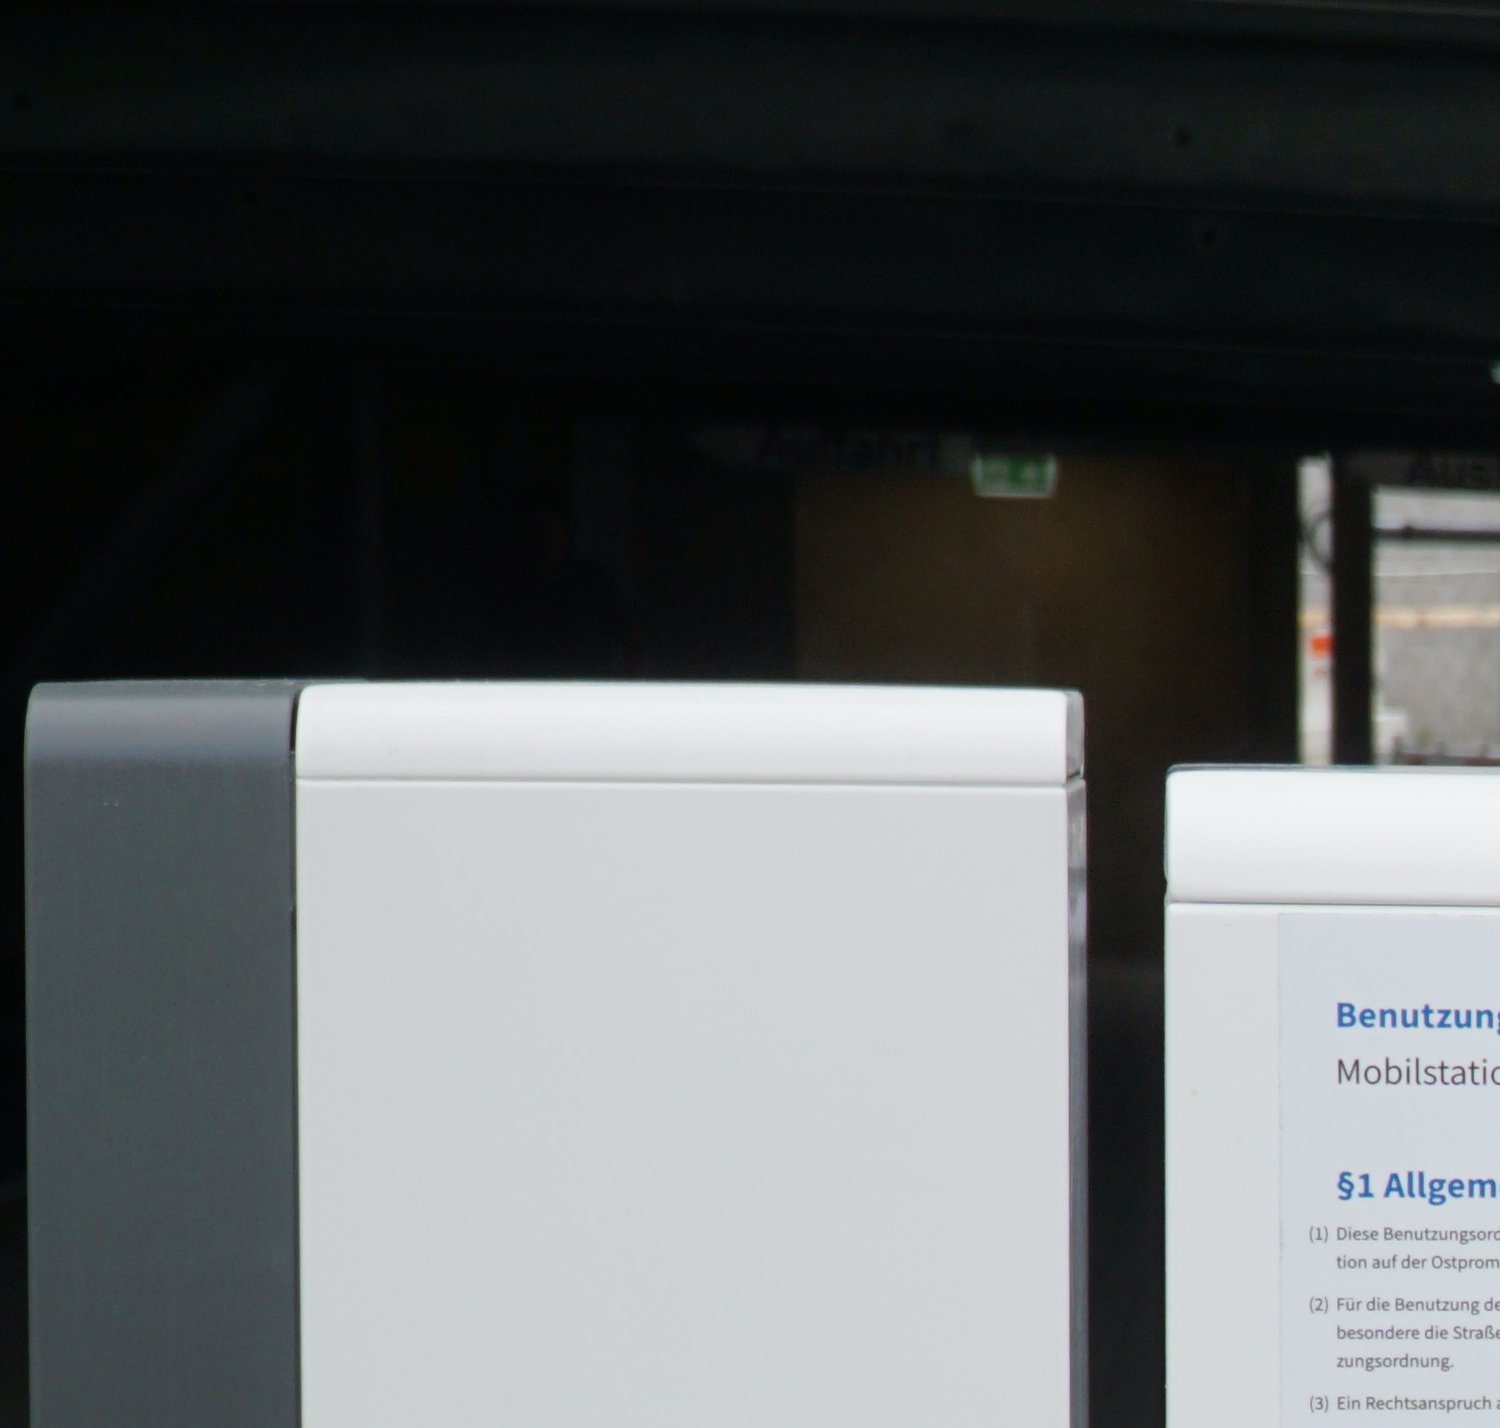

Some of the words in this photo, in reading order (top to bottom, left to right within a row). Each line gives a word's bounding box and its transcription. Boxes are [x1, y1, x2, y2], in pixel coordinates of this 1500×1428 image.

[1337, 1172, 1374, 1202] §1
[1308, 1225, 1328, 1244] (1)
[1336, 1227, 1379, 1242] Diese
[1335, 1255, 1367, 1270] tion
[1371, 1254, 1397, 1270] auf
[1400, 1254, 1427, 1270] der
[1309, 1395, 1329, 1413] (3)
[1336, 1395, 1361, 1410] Ein
[1365, 1395, 1492, 1414] Rechtsanspruch
